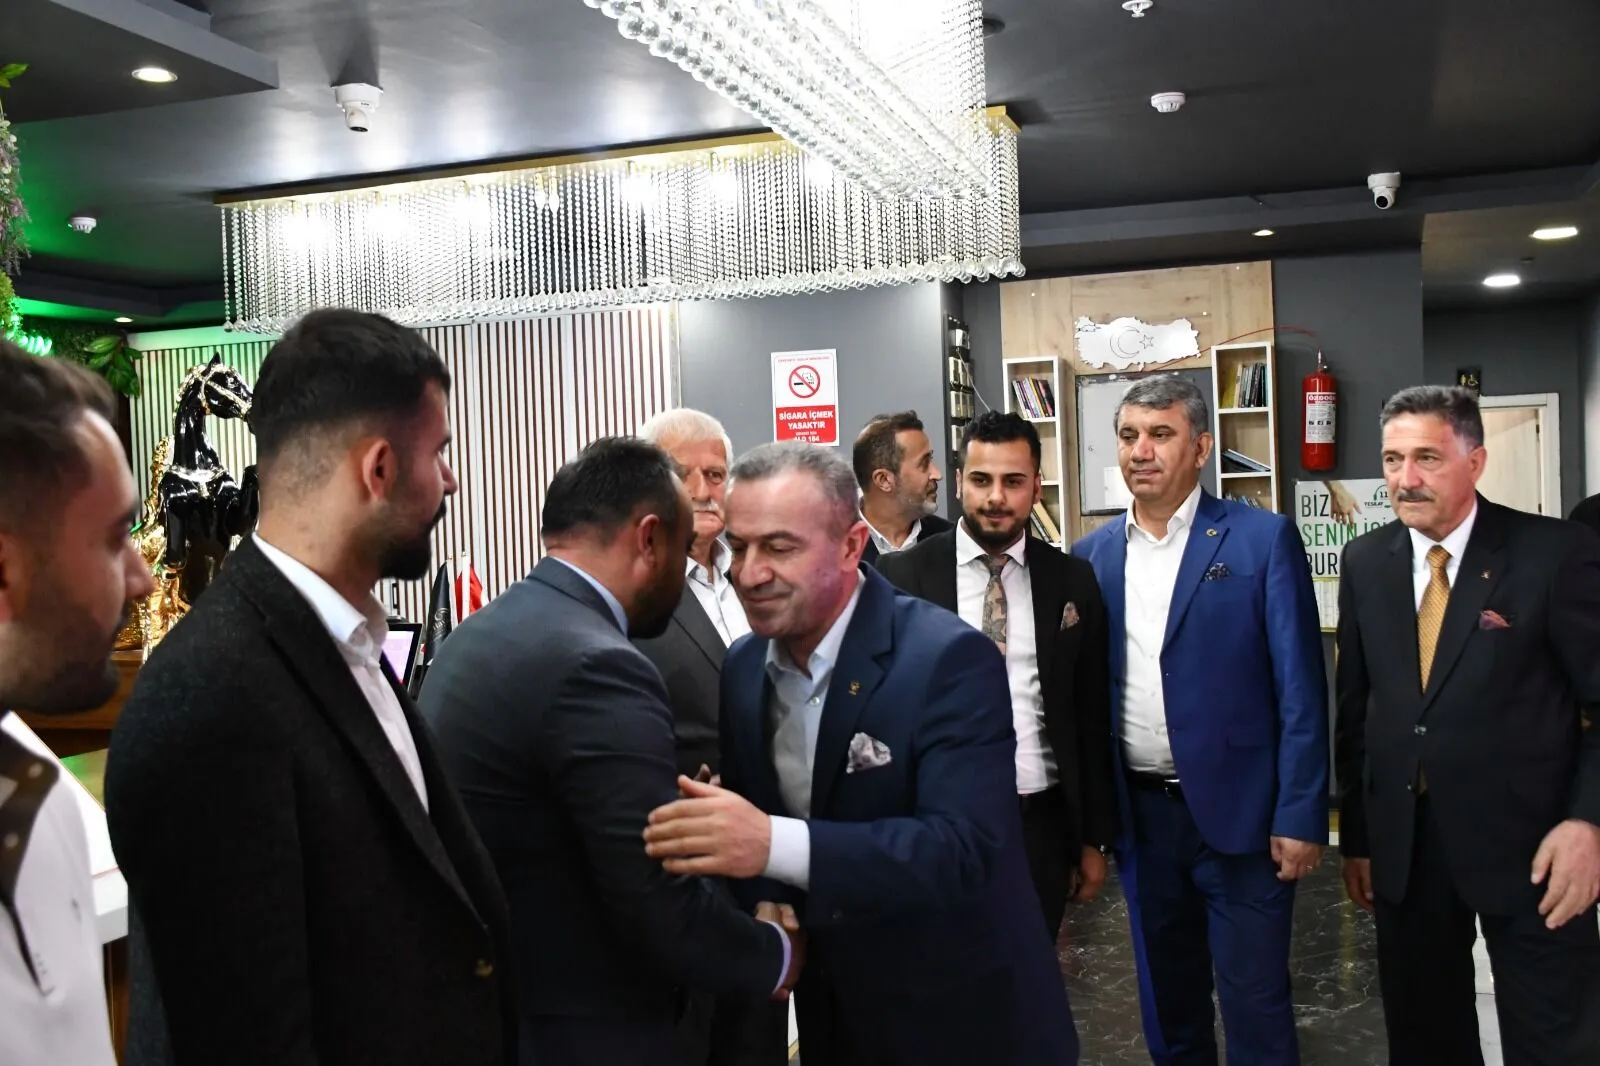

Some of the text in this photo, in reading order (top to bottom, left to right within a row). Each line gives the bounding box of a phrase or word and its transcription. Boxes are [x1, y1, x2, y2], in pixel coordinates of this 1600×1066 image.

[779, 410, 833, 420] SİGARA İÇMEK
[788, 421, 825, 430] YASAKTIR
[1301, 489, 1329, 517] BİZ
